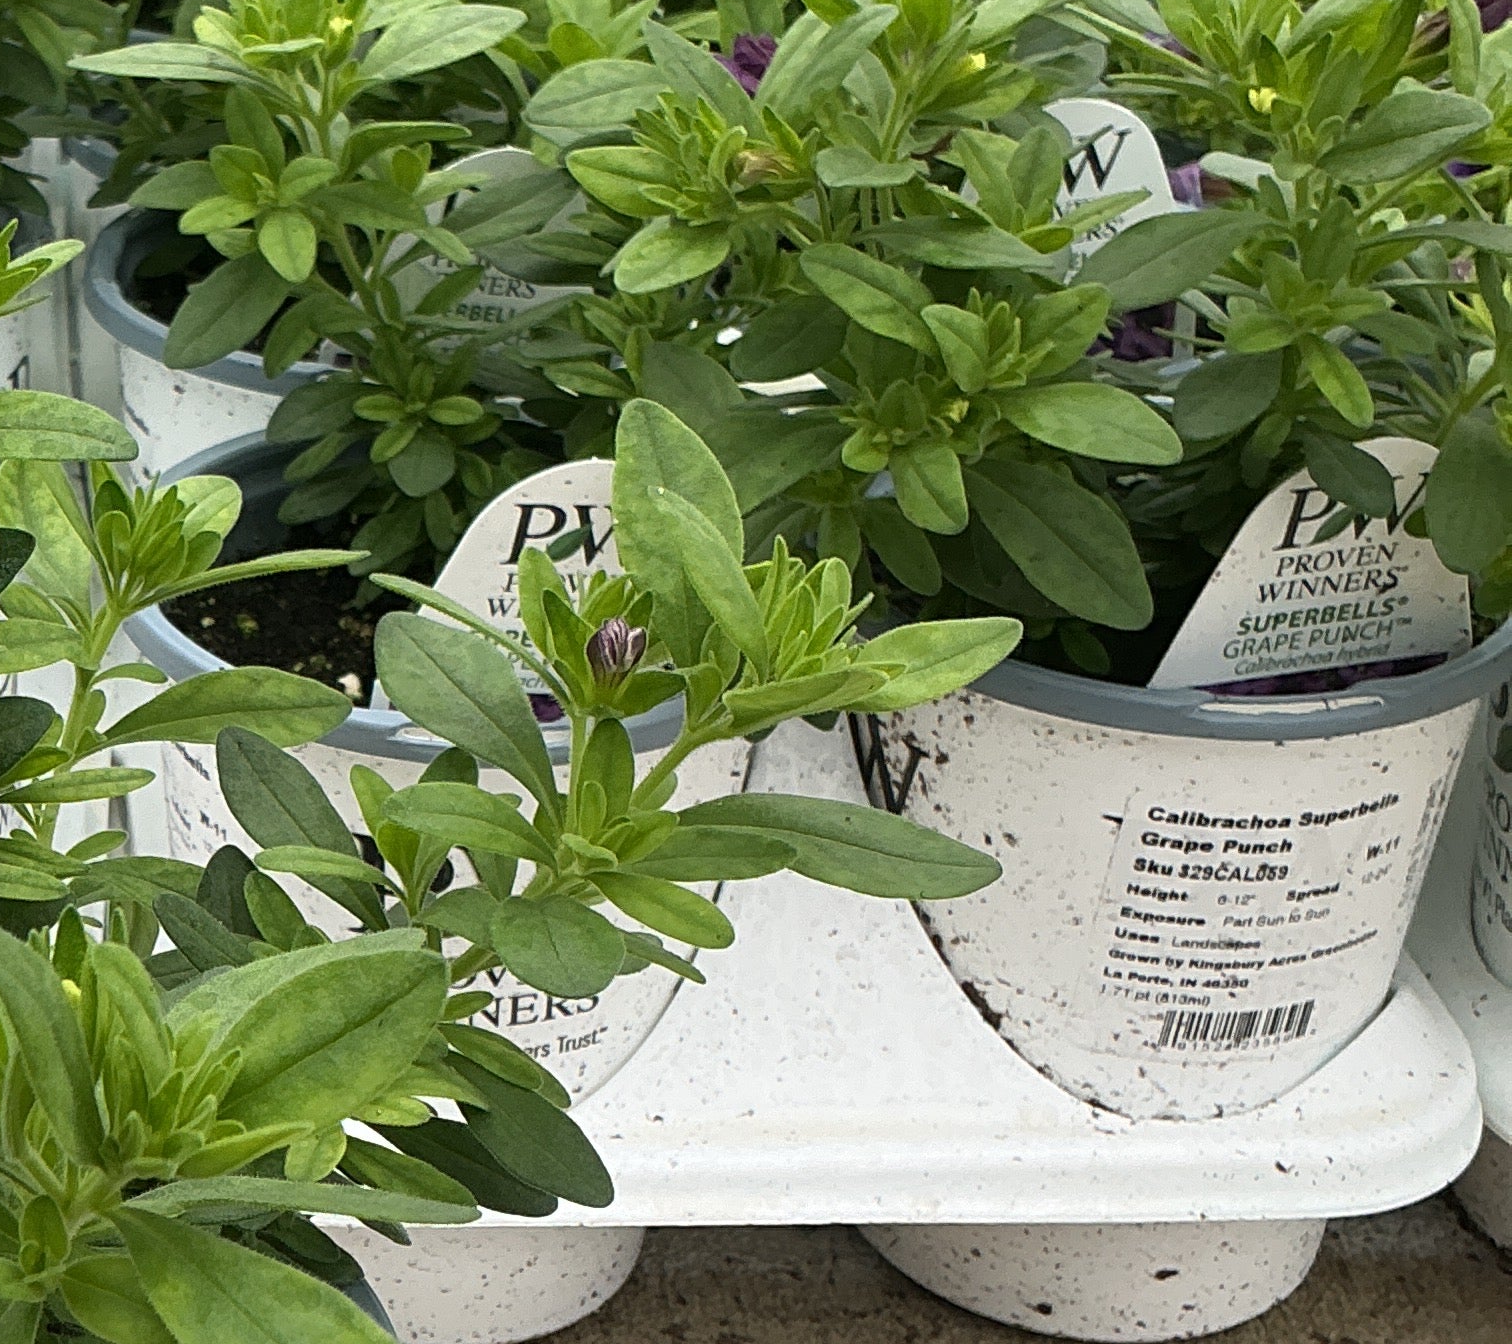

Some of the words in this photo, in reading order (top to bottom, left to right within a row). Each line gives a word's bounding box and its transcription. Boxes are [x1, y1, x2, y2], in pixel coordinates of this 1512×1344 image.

[1276, 542, 1400, 577] PROVEN
[1223, 631, 1304, 660] GRAPE
[1148, 806, 1292, 830] Calibrachoa
[1298, 793, 1399, 827] Superbells
[1140, 831, 1215, 855] Grape
[1222, 838, 1293, 854] Punch
[1133, 857, 1173, 877] Sku
[1126, 883, 1189, 903] Height
[1286, 882, 1340, 903] Spread
[1120, 906, 1206, 926] Exposure
[1256, 914, 1285, 927] Sun
[1288, 910, 1301, 923] to
[1114, 926, 1160, 944] Uses
[1171, 936, 1261, 951] Landscapes
[1108, 948, 1161, 966] Grown
[1165, 956, 1184, 969] by
[1188, 958, 1265, 970] Kingsbury
[1103, 966, 1123, 980] La
[1179, 978, 1197, 988] IN
